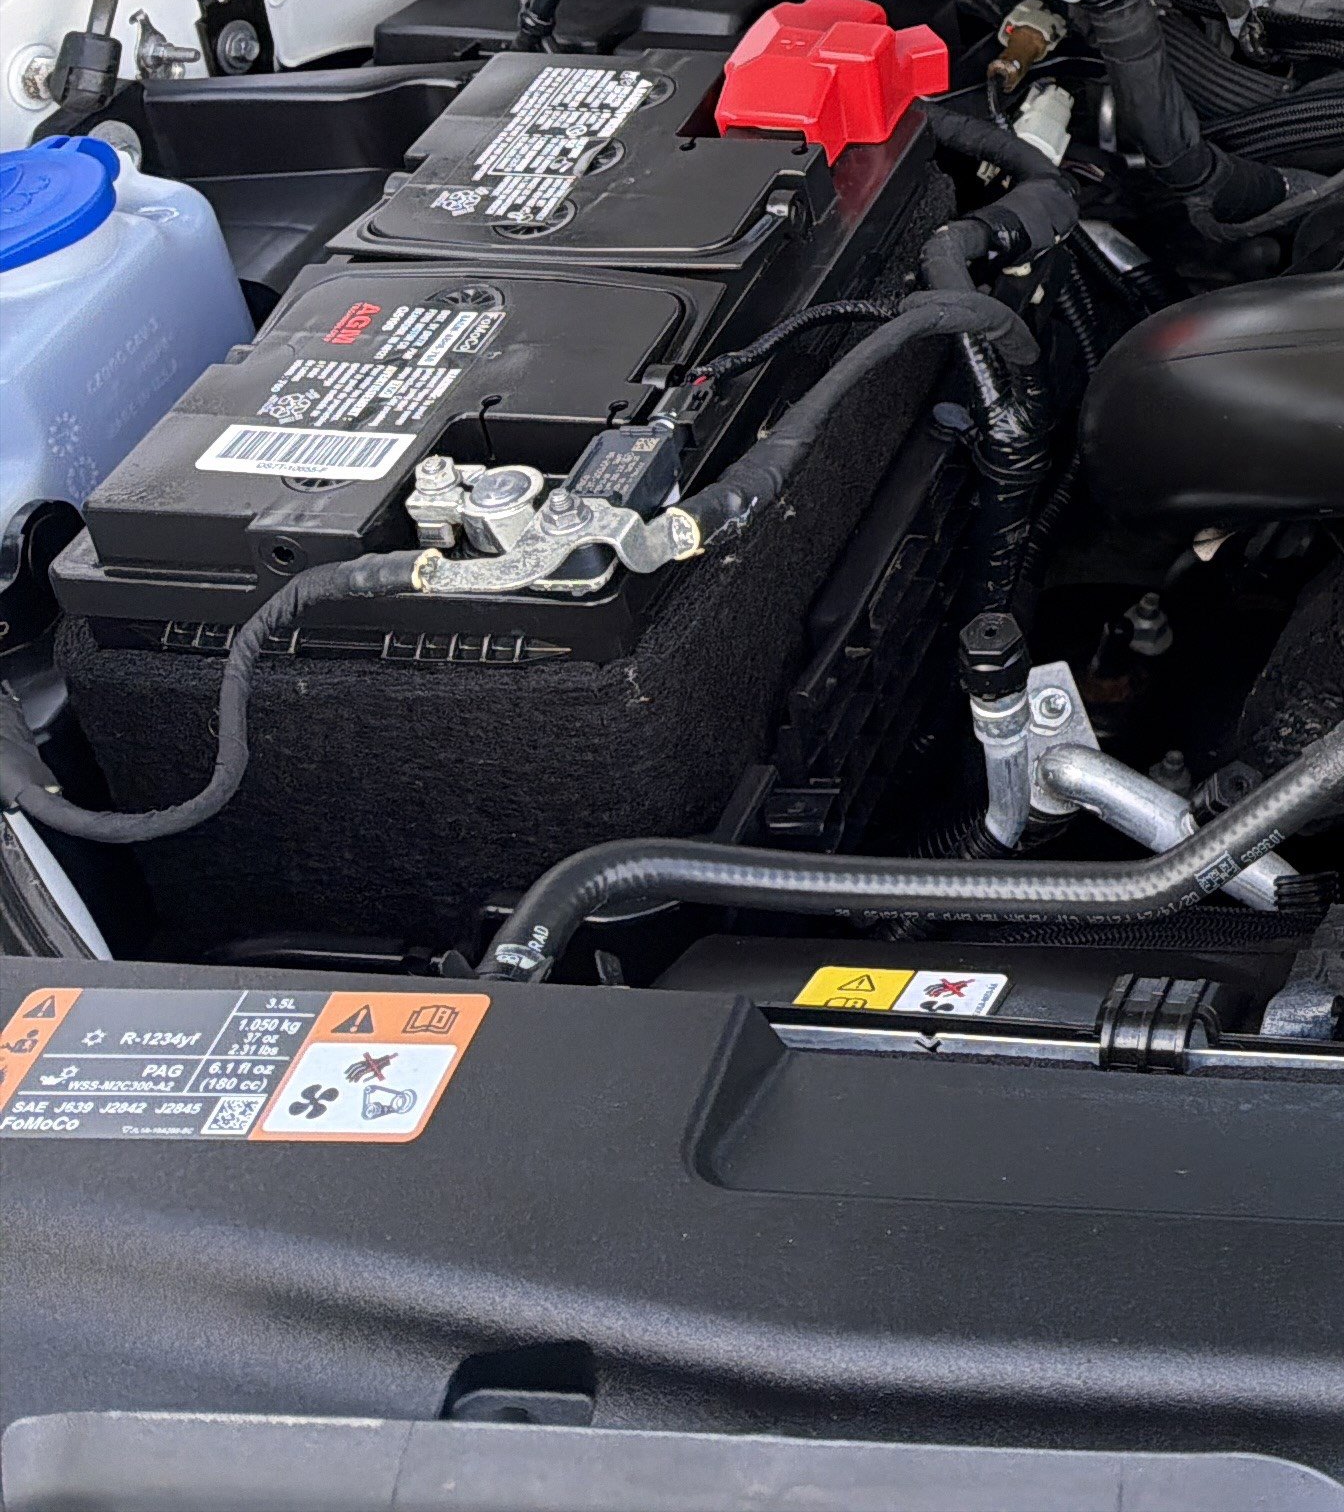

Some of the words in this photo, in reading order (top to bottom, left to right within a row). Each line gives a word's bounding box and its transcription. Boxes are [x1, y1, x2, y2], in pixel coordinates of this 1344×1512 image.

[332, 303, 381, 344] AGM
[528, 925, 549, 952] RAD
[265, 997, 296, 1010] 3.5L
[238, 1018, 279, 1031] 1.050
[280, 1018, 302, 1035] kg
[119, 1031, 202, 1048] R-1234yf
[243, 1032, 262, 1044] 37
[262, 1034, 279, 1044] oz
[228, 1044, 257, 1056] 2.31
[258, 1044, 279, 1056] lbs
[141, 1064, 184, 1078] PAG
[208, 1062, 235, 1075] 6.1
[237, 1062, 252, 1075] fl
[252, 1065, 276, 1075] oz
[67, 1080, 175, 1092] WSS-M2C300-A2
[199, 1077, 238, 1093] (180
[239, 1076, 268, 1093] cc)
[11, 1101, 50, 1114] SAE
[54, 1101, 95, 1114] J639
[99, 1102, 148, 1114] J2842
[155, 1102, 203, 1115] J2845
[0, 1116, 81, 1131] FoMoCo
